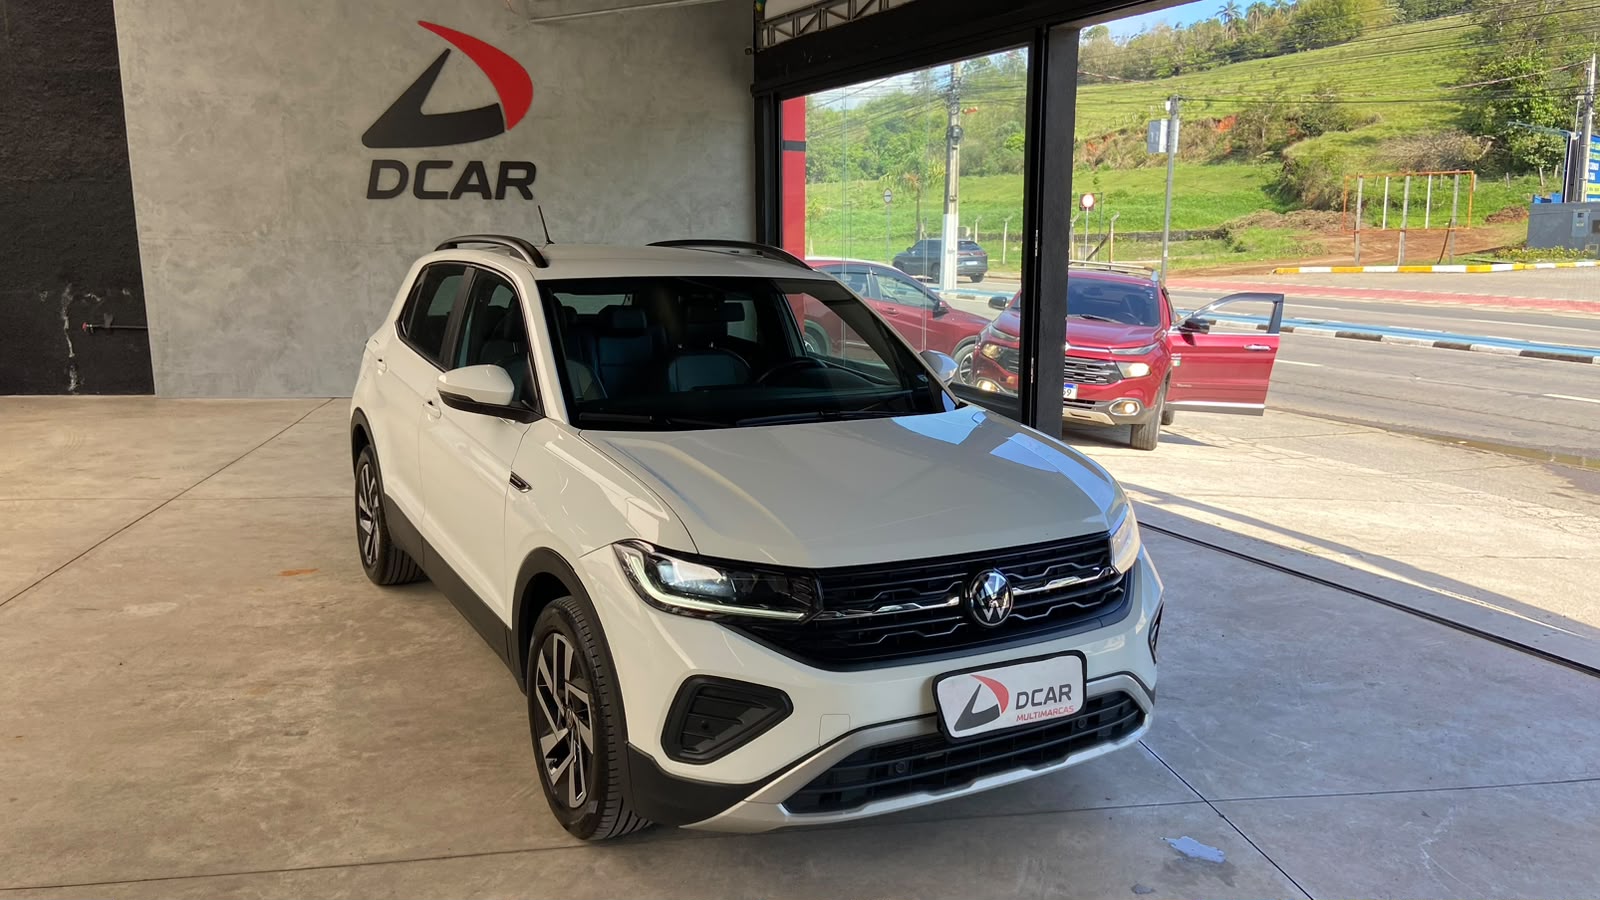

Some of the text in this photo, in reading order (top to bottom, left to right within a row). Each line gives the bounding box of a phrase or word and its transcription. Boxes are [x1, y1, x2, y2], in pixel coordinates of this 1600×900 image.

[366, 159, 536, 200] DCAR
[1015, 683, 1072, 710] DCAR
[1016, 705, 1075, 722] MULTIMARCAS
